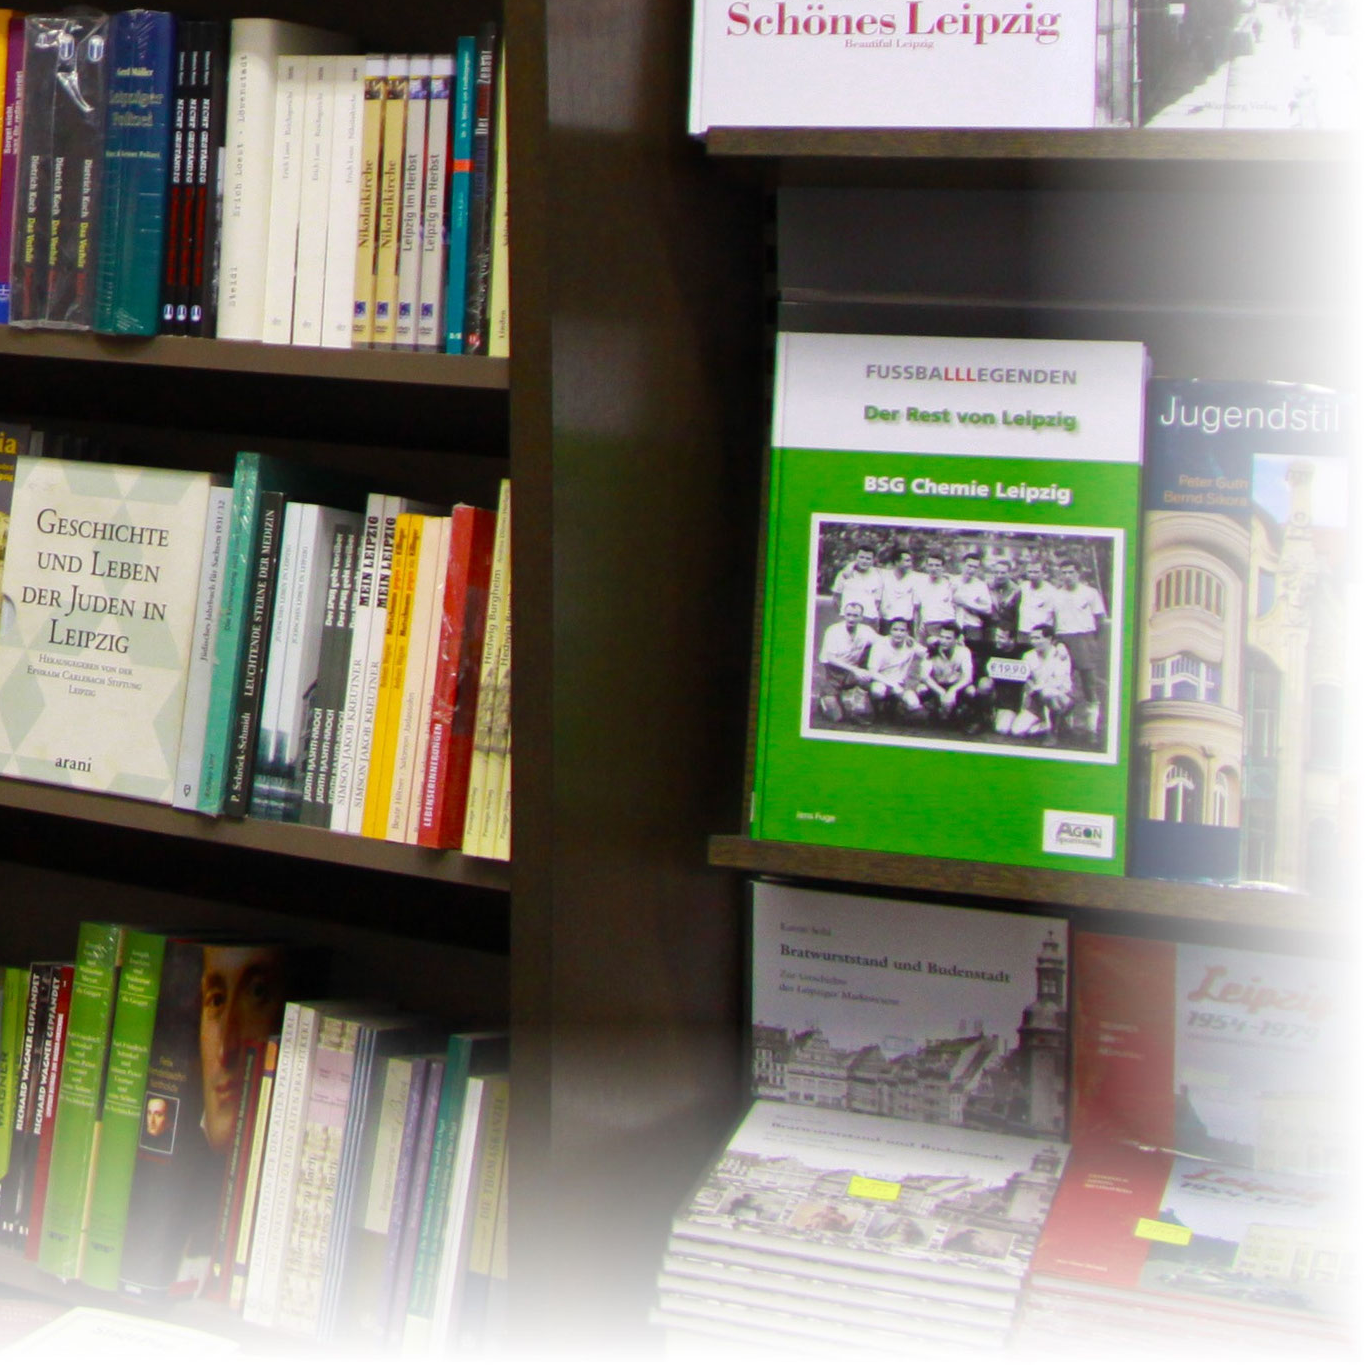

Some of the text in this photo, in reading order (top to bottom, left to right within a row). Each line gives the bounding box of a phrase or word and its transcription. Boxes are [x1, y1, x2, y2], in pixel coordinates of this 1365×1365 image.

[727, 1, 1061, 45] Schönes Leipzig
[844, 38, 933, 50] Beautiful Leipzig
[359, 160, 373, 248] Nikolaikirche
[381, 159, 396, 248] Nikolaikirche
[402, 154, 417, 252] Leipzig im Herbst
[425, 154, 440, 252] Leipzig im Herbst
[865, 363, 1077, 385] FUSSBALLLEGENDEN
[863, 405, 1078, 431] Der Rest von Leipzig
[1161, 396, 1340, 433] Jugendstil
[864, 476, 1072, 505] BSG Chemie Leipzig
[1165, 491, 1203, 503] Bernd
[1179, 475, 1212, 487] Peter
[261, 509, 275, 556] MEDIZIN
[258, 559, 267, 582] DER
[254, 584, 266, 623] STERNE
[484, 569, 502, 665] Hedwig Burgheim
[244, 625, 260, 697] LEUCHTENDE
[55, 755, 92, 773] arani
[424, 723, 442, 828] LEBENSERINNERUNGEN
[780, 944, 1010, 983] Bratwurststand und Budenstadt
[15, 1077, 28, 1131] RICHARD
[22, 1029, 34, 1075] WAGNER
